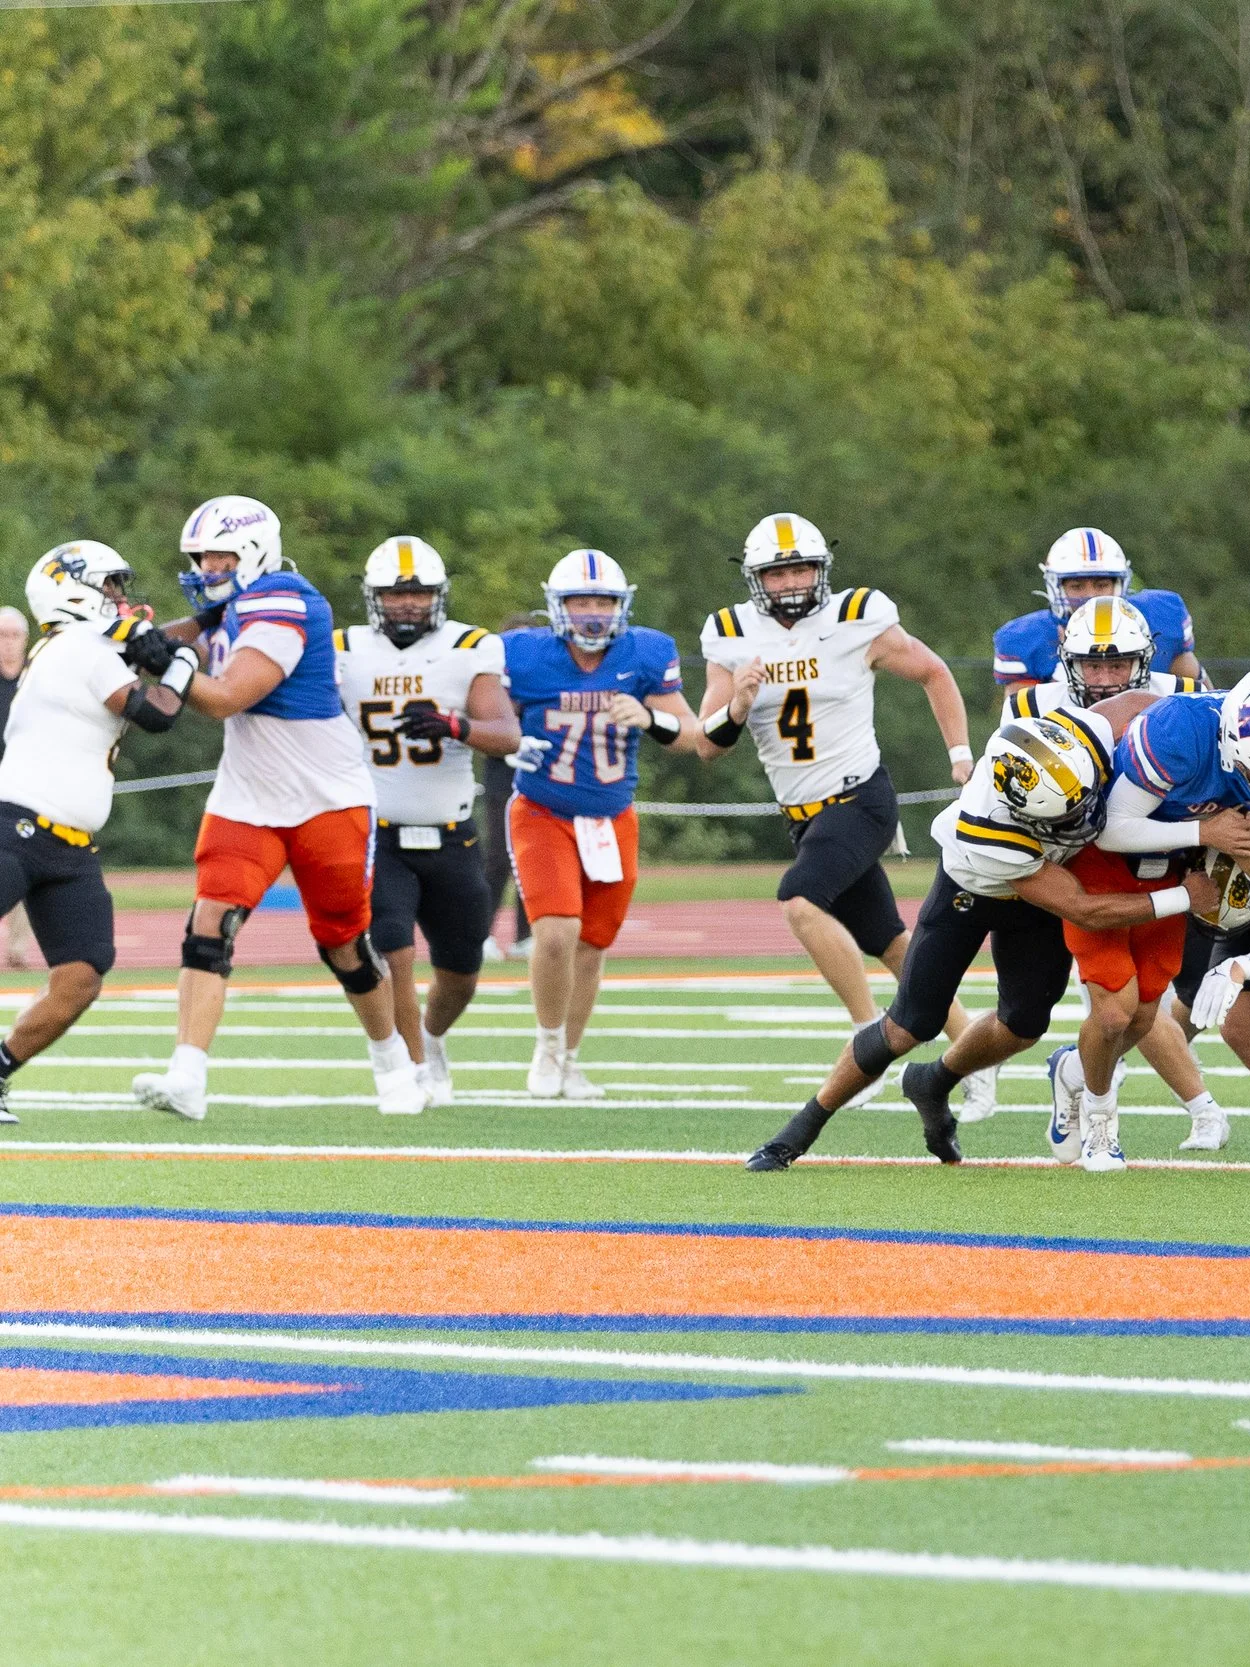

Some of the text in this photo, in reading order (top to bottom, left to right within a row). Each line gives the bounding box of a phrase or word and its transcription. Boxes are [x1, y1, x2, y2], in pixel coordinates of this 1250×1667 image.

[764, 658, 818, 684] NEERS
[373, 674, 423, 696] NEERS
[559, 690, 619, 712] BRUIN
[776, 687, 815, 763] 4
[544, 708, 629, 784] 70
